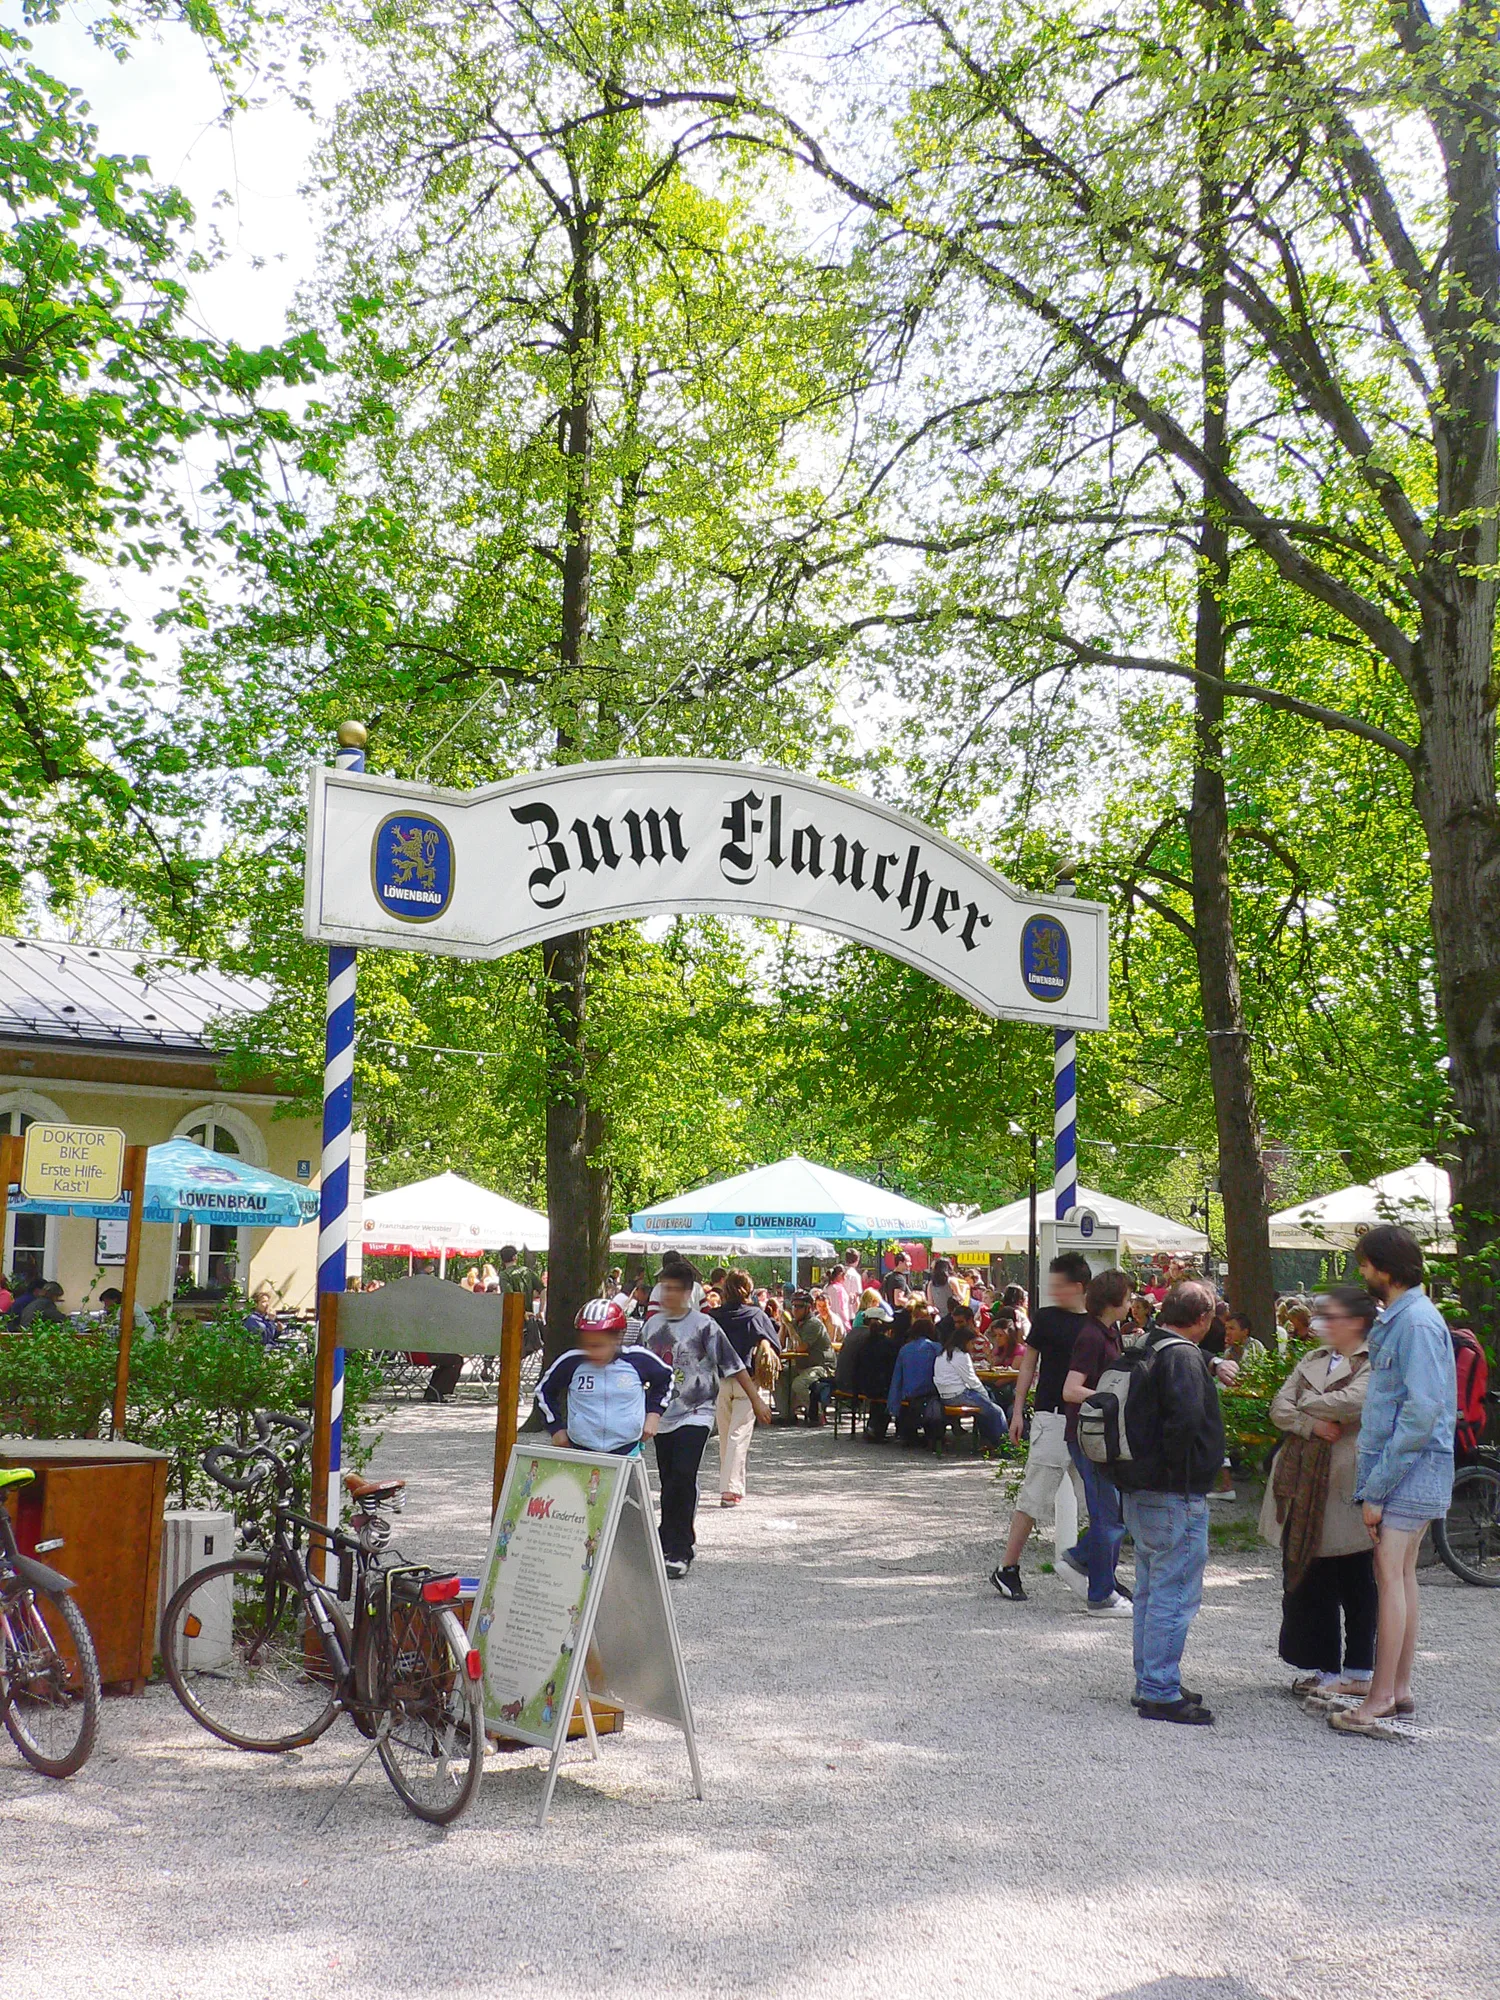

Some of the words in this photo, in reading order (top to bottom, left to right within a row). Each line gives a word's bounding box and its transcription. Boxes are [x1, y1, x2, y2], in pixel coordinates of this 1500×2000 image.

[509, 802, 690, 910] Zum
[719, 788, 994, 952] Flaucher
[383, 884, 442, 904] LÖWENBRÄU
[43, 1130, 105, 1146] DOKTOR
[59, 1146, 89, 1160] BIKE
[40, 1163, 70, 1176] Erste
[74, 1164, 107, 1178] Hilfe-
[178, 1190, 267, 1210] LÖWENBRÄU
[747, 1215, 817, 1228] LÖWENBRÄU
[577, 1376, 595, 1390] 25
